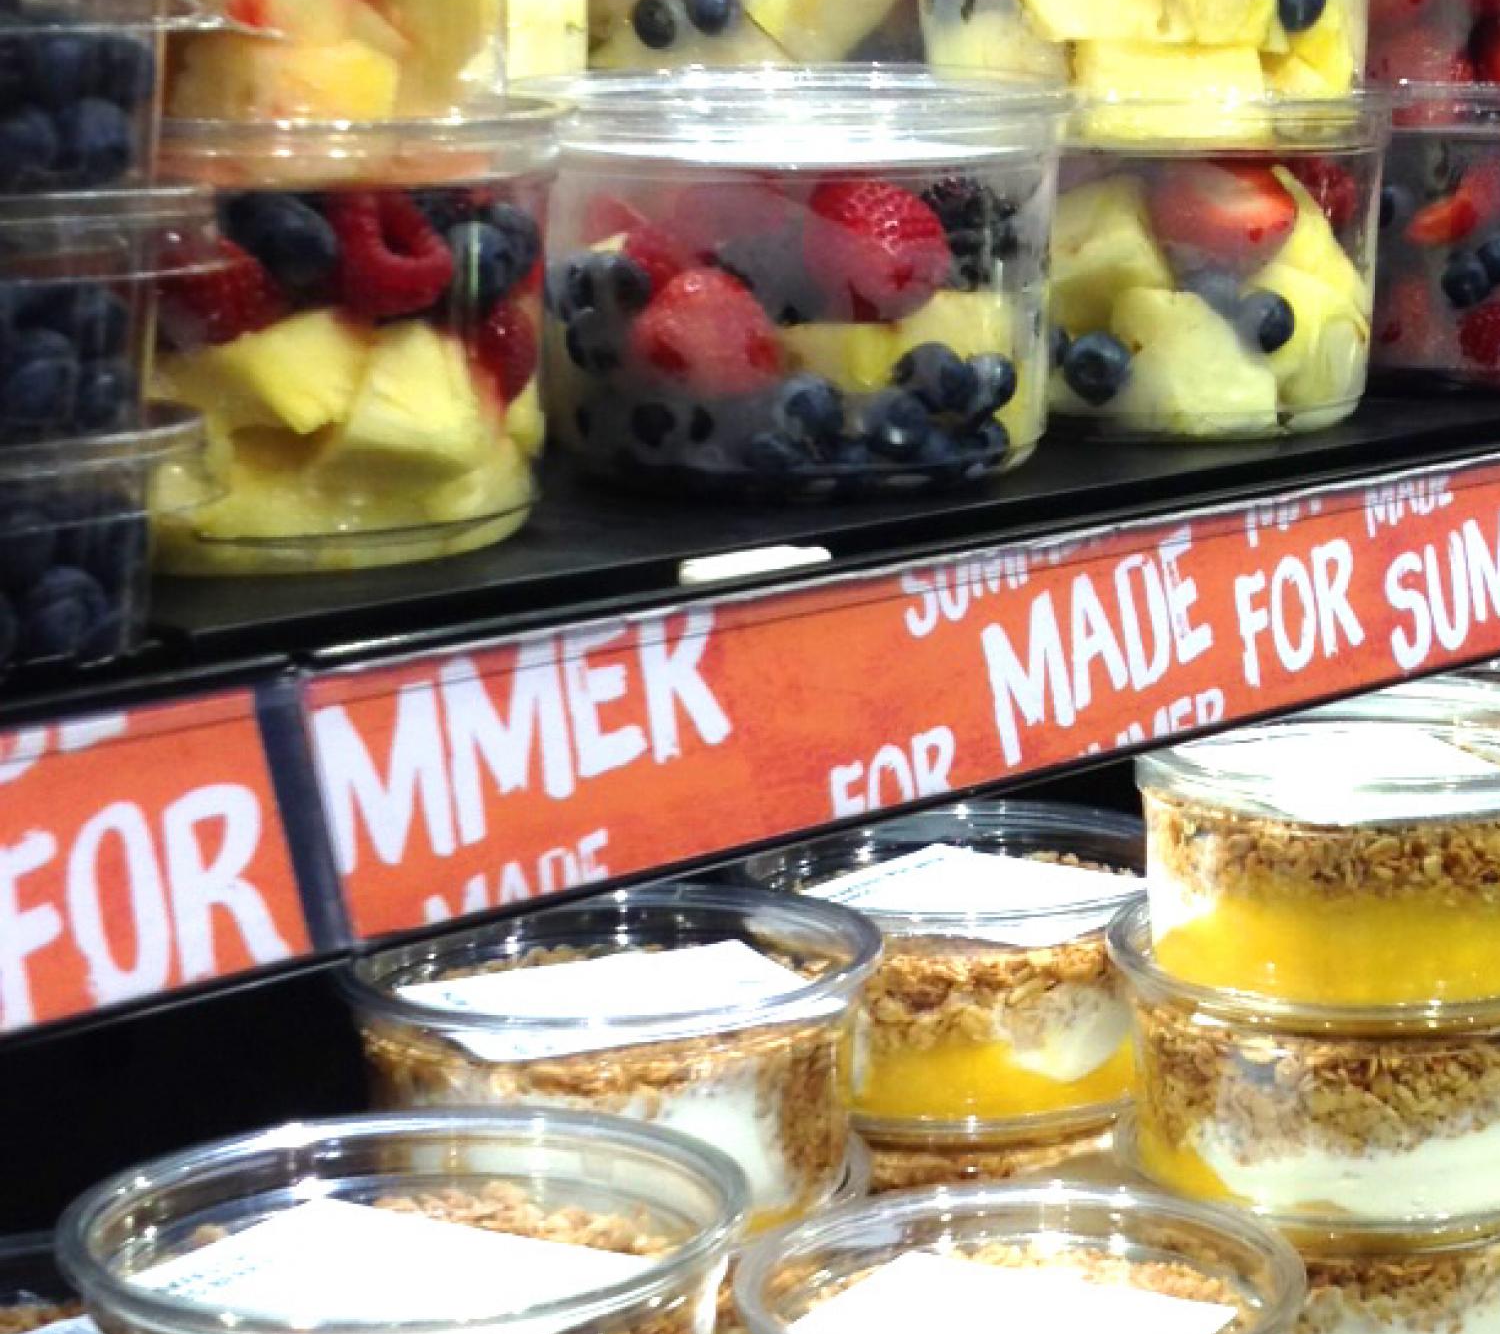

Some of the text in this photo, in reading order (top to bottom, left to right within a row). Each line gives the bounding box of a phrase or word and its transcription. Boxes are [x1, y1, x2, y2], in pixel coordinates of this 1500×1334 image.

[980, 525, 1212, 766] MADE
[1234, 539, 1365, 688] FOR
[0, 783, 292, 1031] FOR
